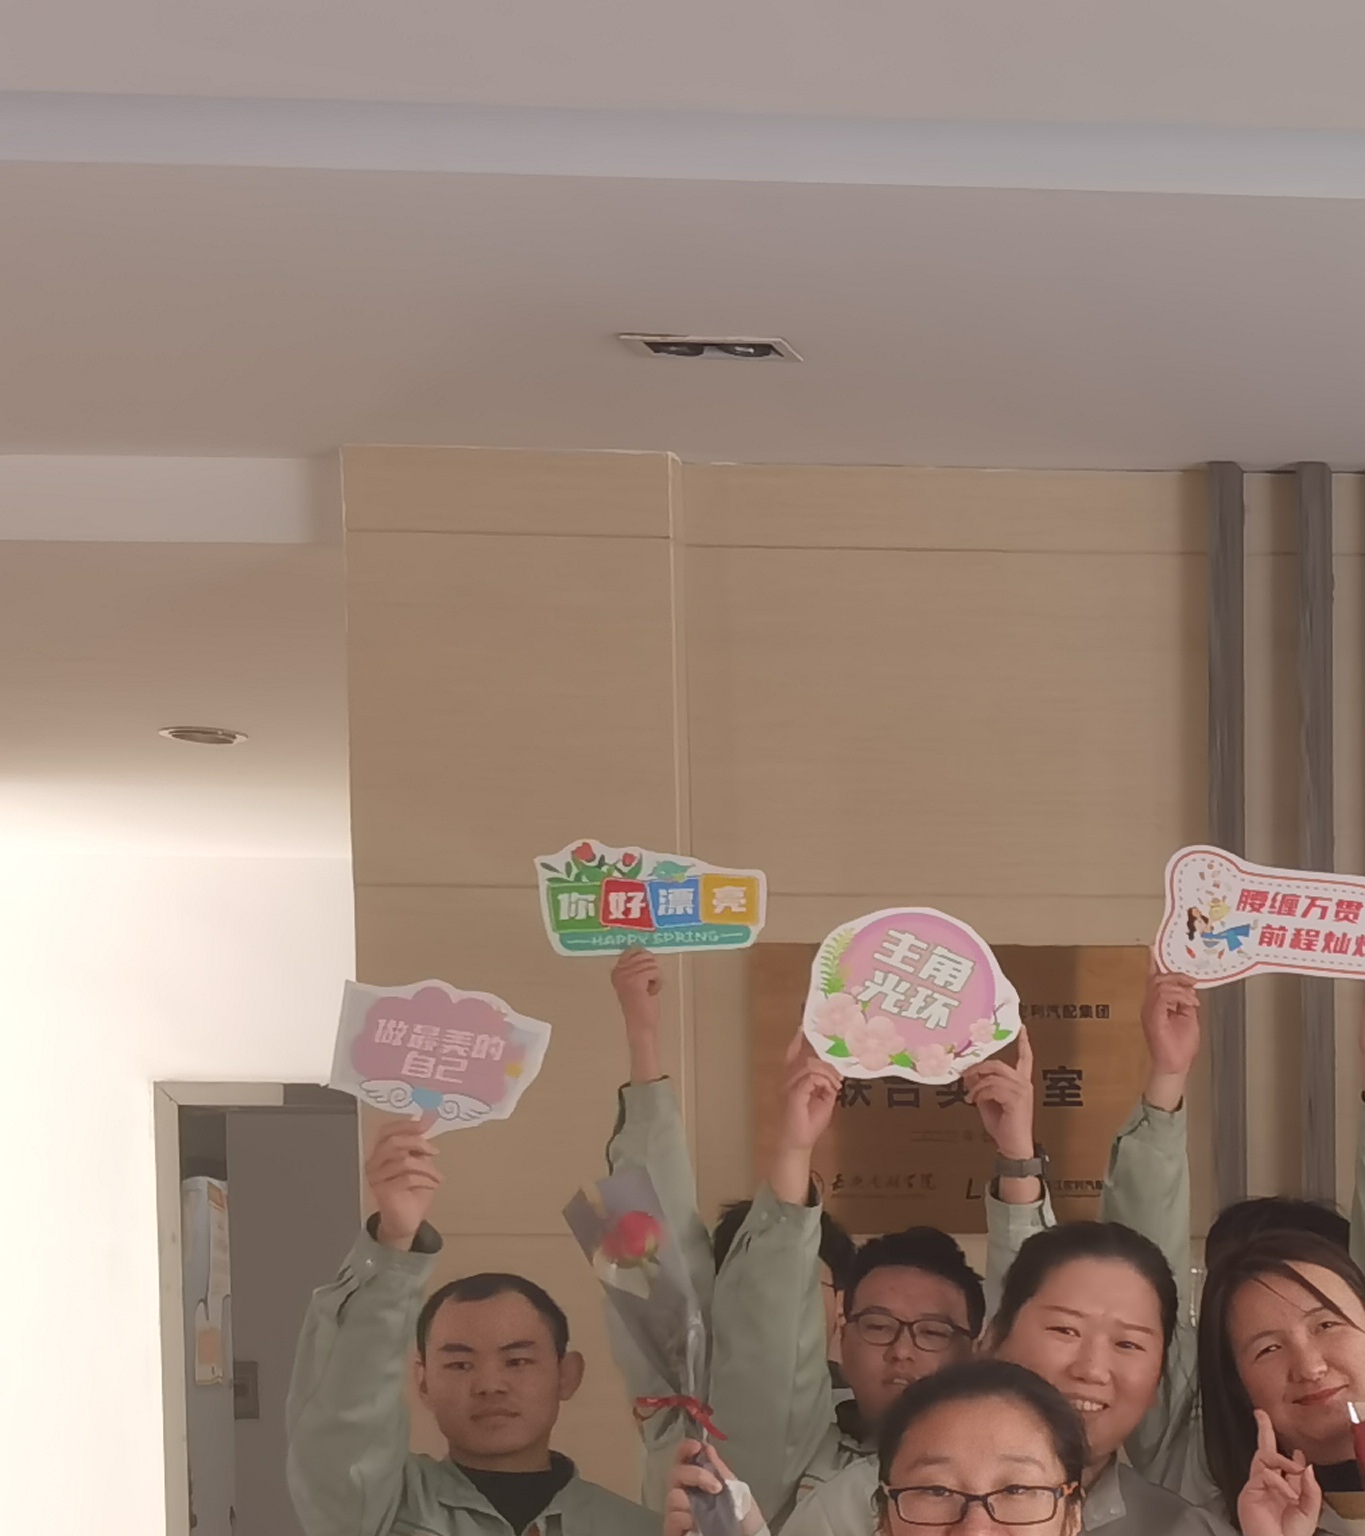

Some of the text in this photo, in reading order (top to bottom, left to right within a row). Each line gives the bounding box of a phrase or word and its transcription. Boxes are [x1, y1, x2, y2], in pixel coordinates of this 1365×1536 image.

[557, 886, 748, 920] 你好漂亮
[1236, 889, 1364, 924] 腰缠万贯
[592, 930, 719, 946] HAPPY SPRING
[873, 929, 976, 992] 主角
[857, 970, 960, 1030] 光环
[374, 1018, 506, 1061] 做最美的
[401, 1051, 468, 1084] 自己
